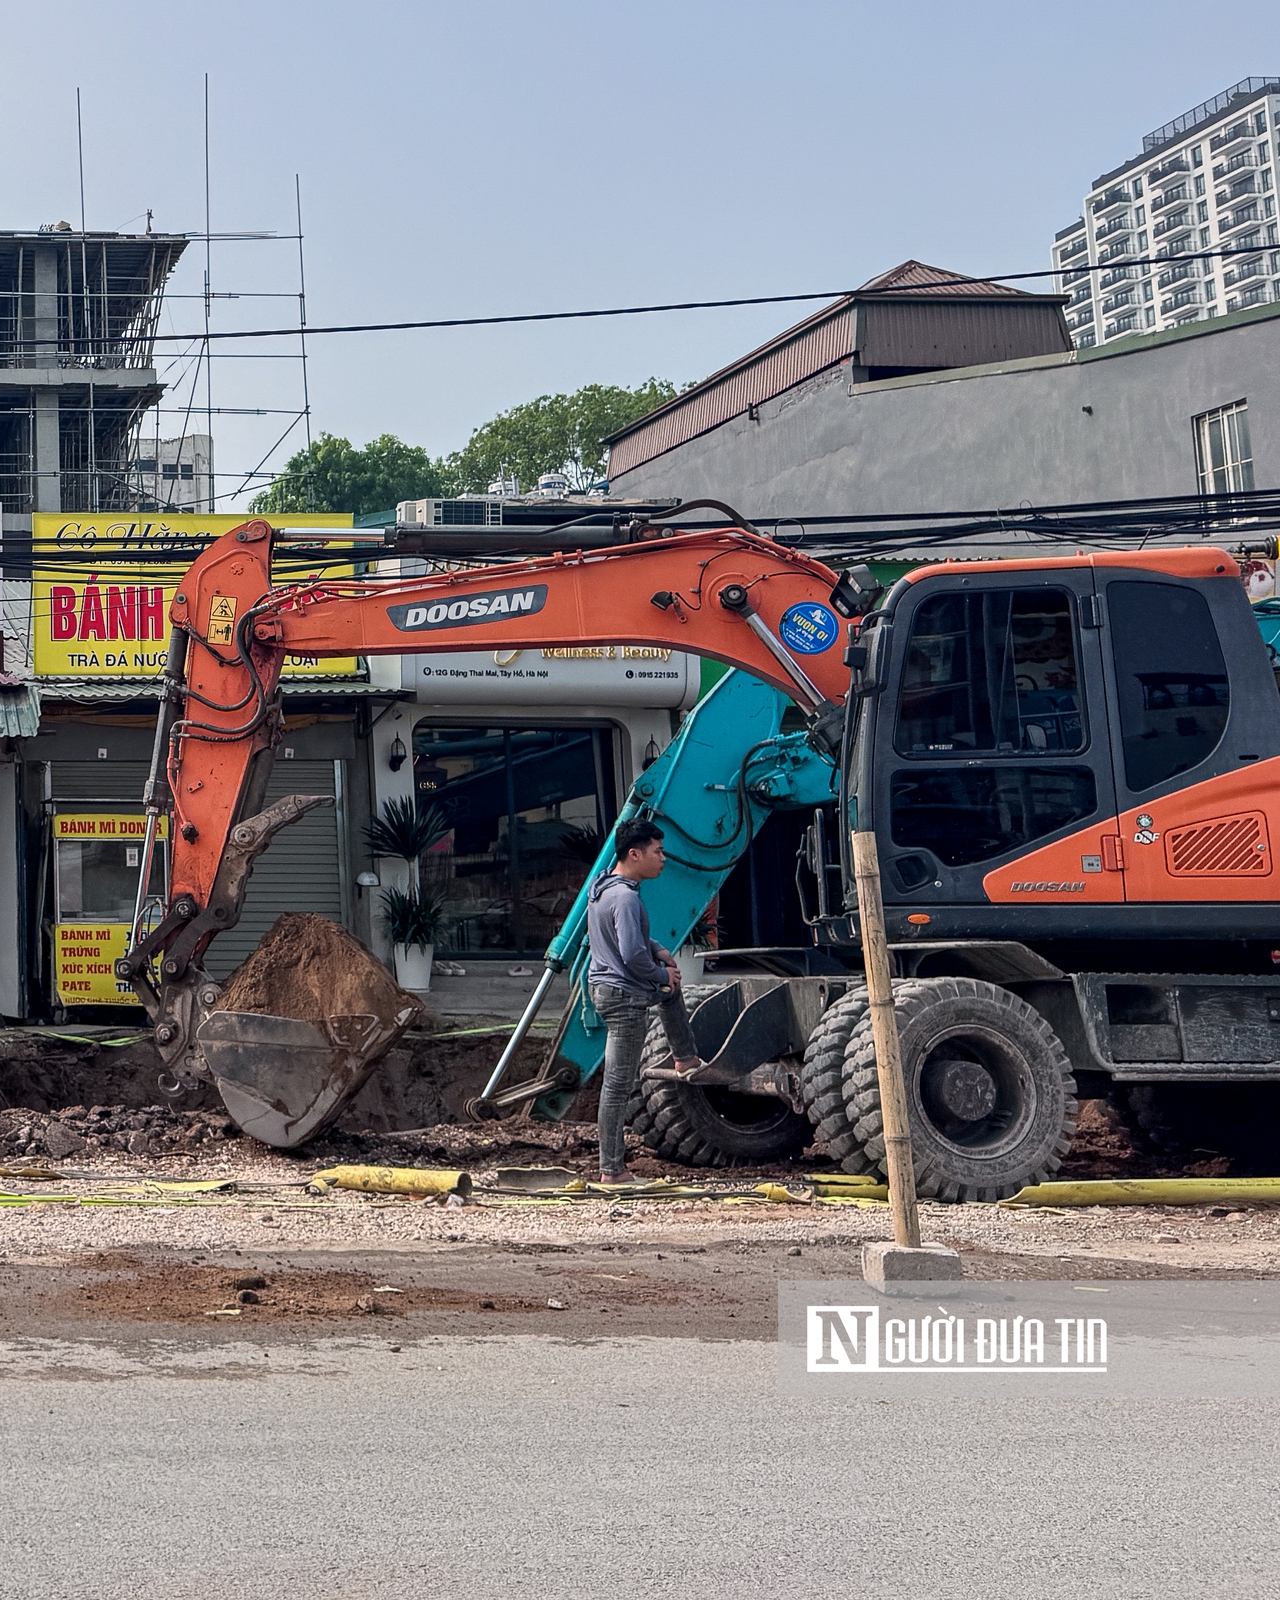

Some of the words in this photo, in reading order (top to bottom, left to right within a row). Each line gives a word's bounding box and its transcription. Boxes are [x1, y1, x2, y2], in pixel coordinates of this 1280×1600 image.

[50, 574, 164, 641] BÁNH
[405, 591, 535, 627] DOOSAN
[68, 652, 97, 667] TRÀ
[105, 651, 128, 667] ĐÁ
[541, 647, 604, 658] Wellness
[607, 647, 617, 659] &
[60, 819, 96, 834] BÁNH
[99, 819, 115, 834] MÌ
[1010, 882, 1085, 892] DOOSAN
[61, 928, 93, 941] BÁNH
[96, 929, 111, 941] MÌ
[62, 962, 84, 974] XÚC
[86, 962, 112, 974] XÍCH
[62, 981, 91, 991] PATE
